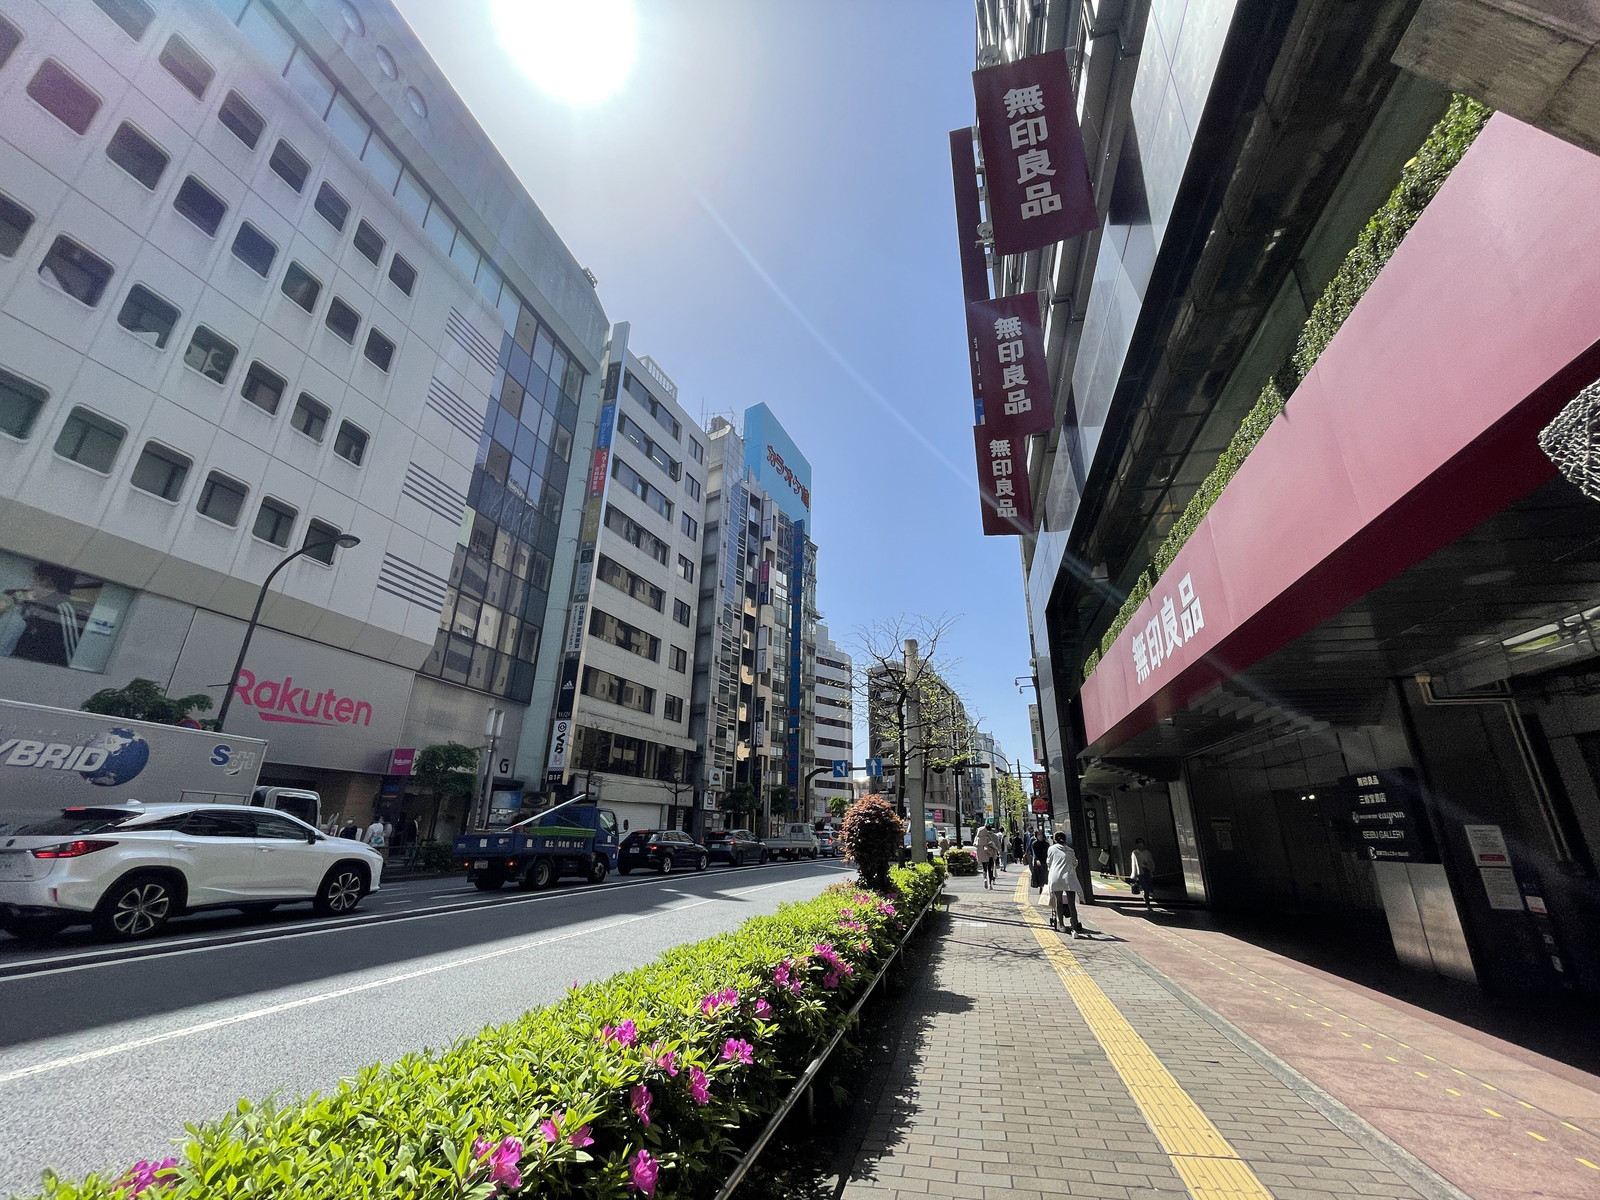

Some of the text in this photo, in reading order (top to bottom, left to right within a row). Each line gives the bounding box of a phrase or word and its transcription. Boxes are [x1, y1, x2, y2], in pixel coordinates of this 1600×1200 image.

[1002, 83, 1063, 220] 無印良品
[993, 315, 1032, 417] 無印良品
[989, 439, 1018, 519] 無印良品
[1131, 572, 1205, 685] 無印良品
[233, 668, 372, 727] Rakuten
[1362, 829, 1405, 839] SEIBU GALLERY
